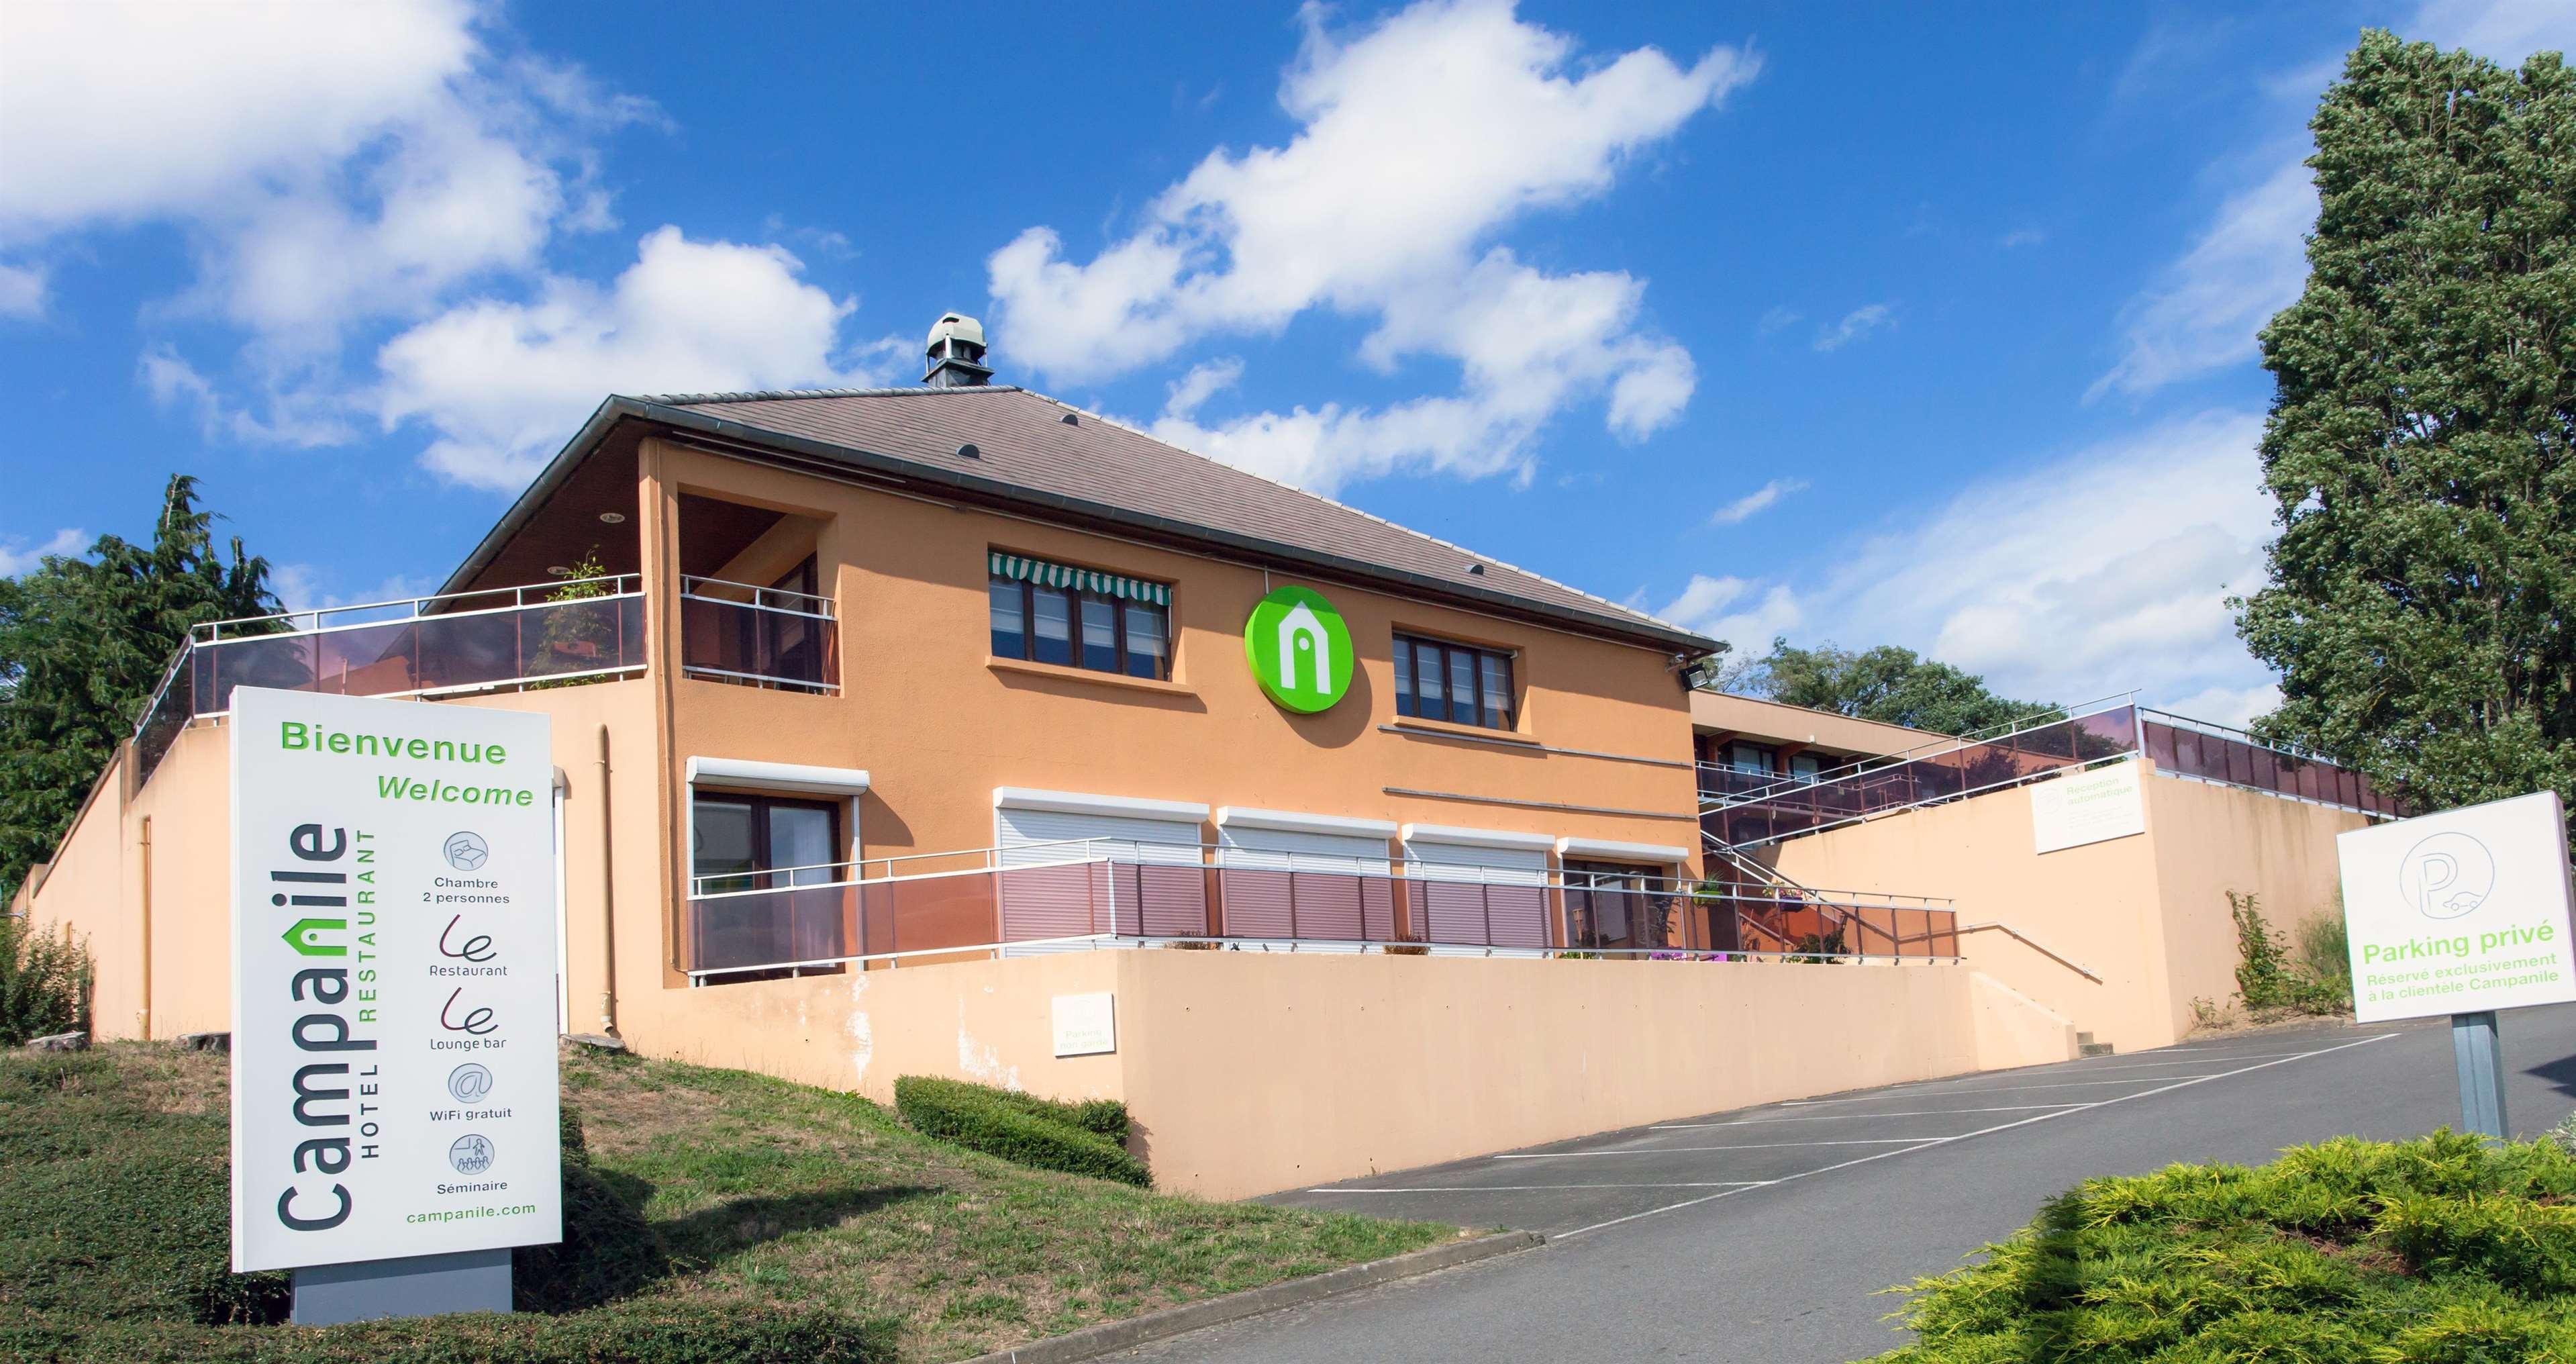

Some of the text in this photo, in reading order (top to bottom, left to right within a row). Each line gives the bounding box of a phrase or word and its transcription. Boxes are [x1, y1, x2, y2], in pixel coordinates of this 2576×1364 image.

[282, 722, 507, 765] Bienvenue
[378, 775, 534, 806] Welcome
[434, 877, 499, 889] Chambre
[423, 892, 510, 905] 2 personnes
[2363, 919, 2554, 965] Parking privé
[430, 965, 507, 977] Restaurant
[2367, 953, 2557, 986] Réservé exclusivement
[357, 830, 379, 1159] HOTEL RESTAURANT
[2368, 971, 2559, 1002] à la clientèle Campanile
[270, 823, 377, 1232] Campanile
[430, 1038, 507, 1051] Lounge bar
[430, 1108, 512, 1122] WiFi gratuit
[437, 1181, 507, 1195] Séminaire
[407, 1204, 536, 1224] campanile.com
